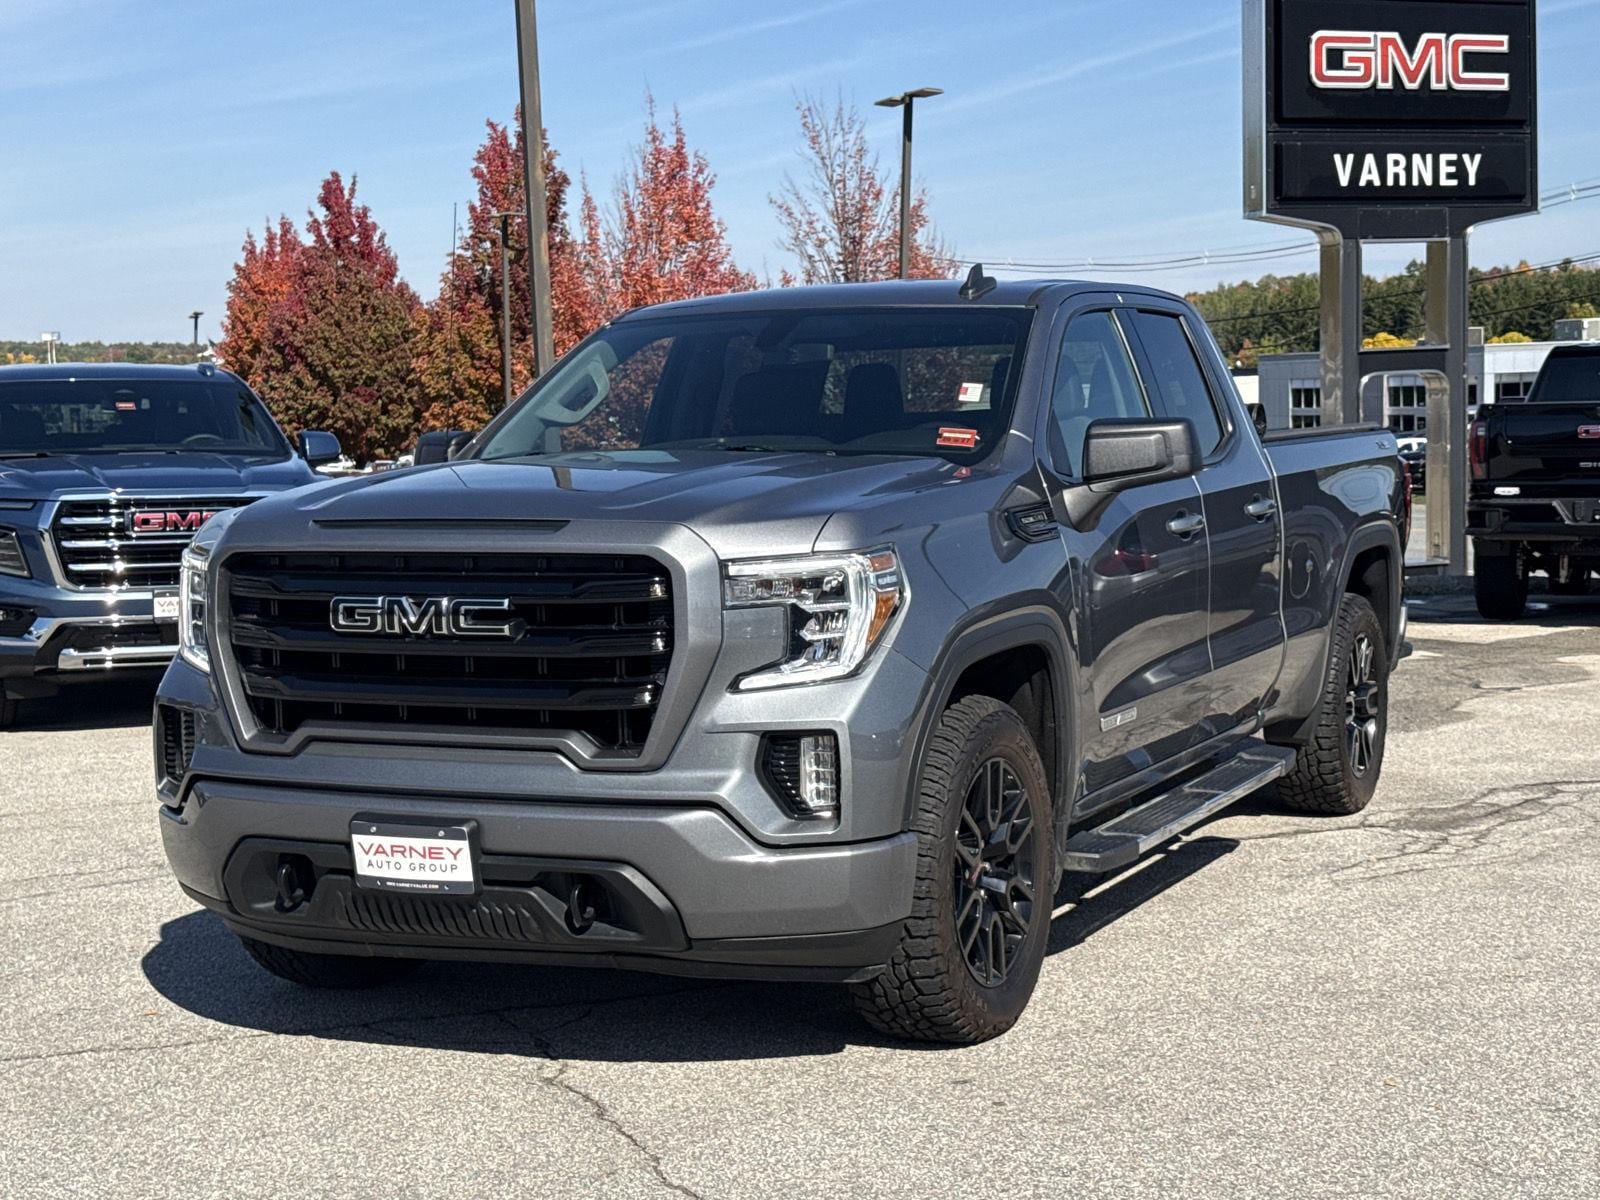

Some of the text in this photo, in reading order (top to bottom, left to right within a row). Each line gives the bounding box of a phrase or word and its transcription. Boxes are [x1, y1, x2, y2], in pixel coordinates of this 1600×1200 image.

[1310, 30, 1509, 91] GMC
[1333, 153, 1482, 187] VARNEY
[329, 596, 511, 636] GMC
[357, 842, 464, 860] VARNEY
[366, 859, 459, 873] AUTO GROUP
